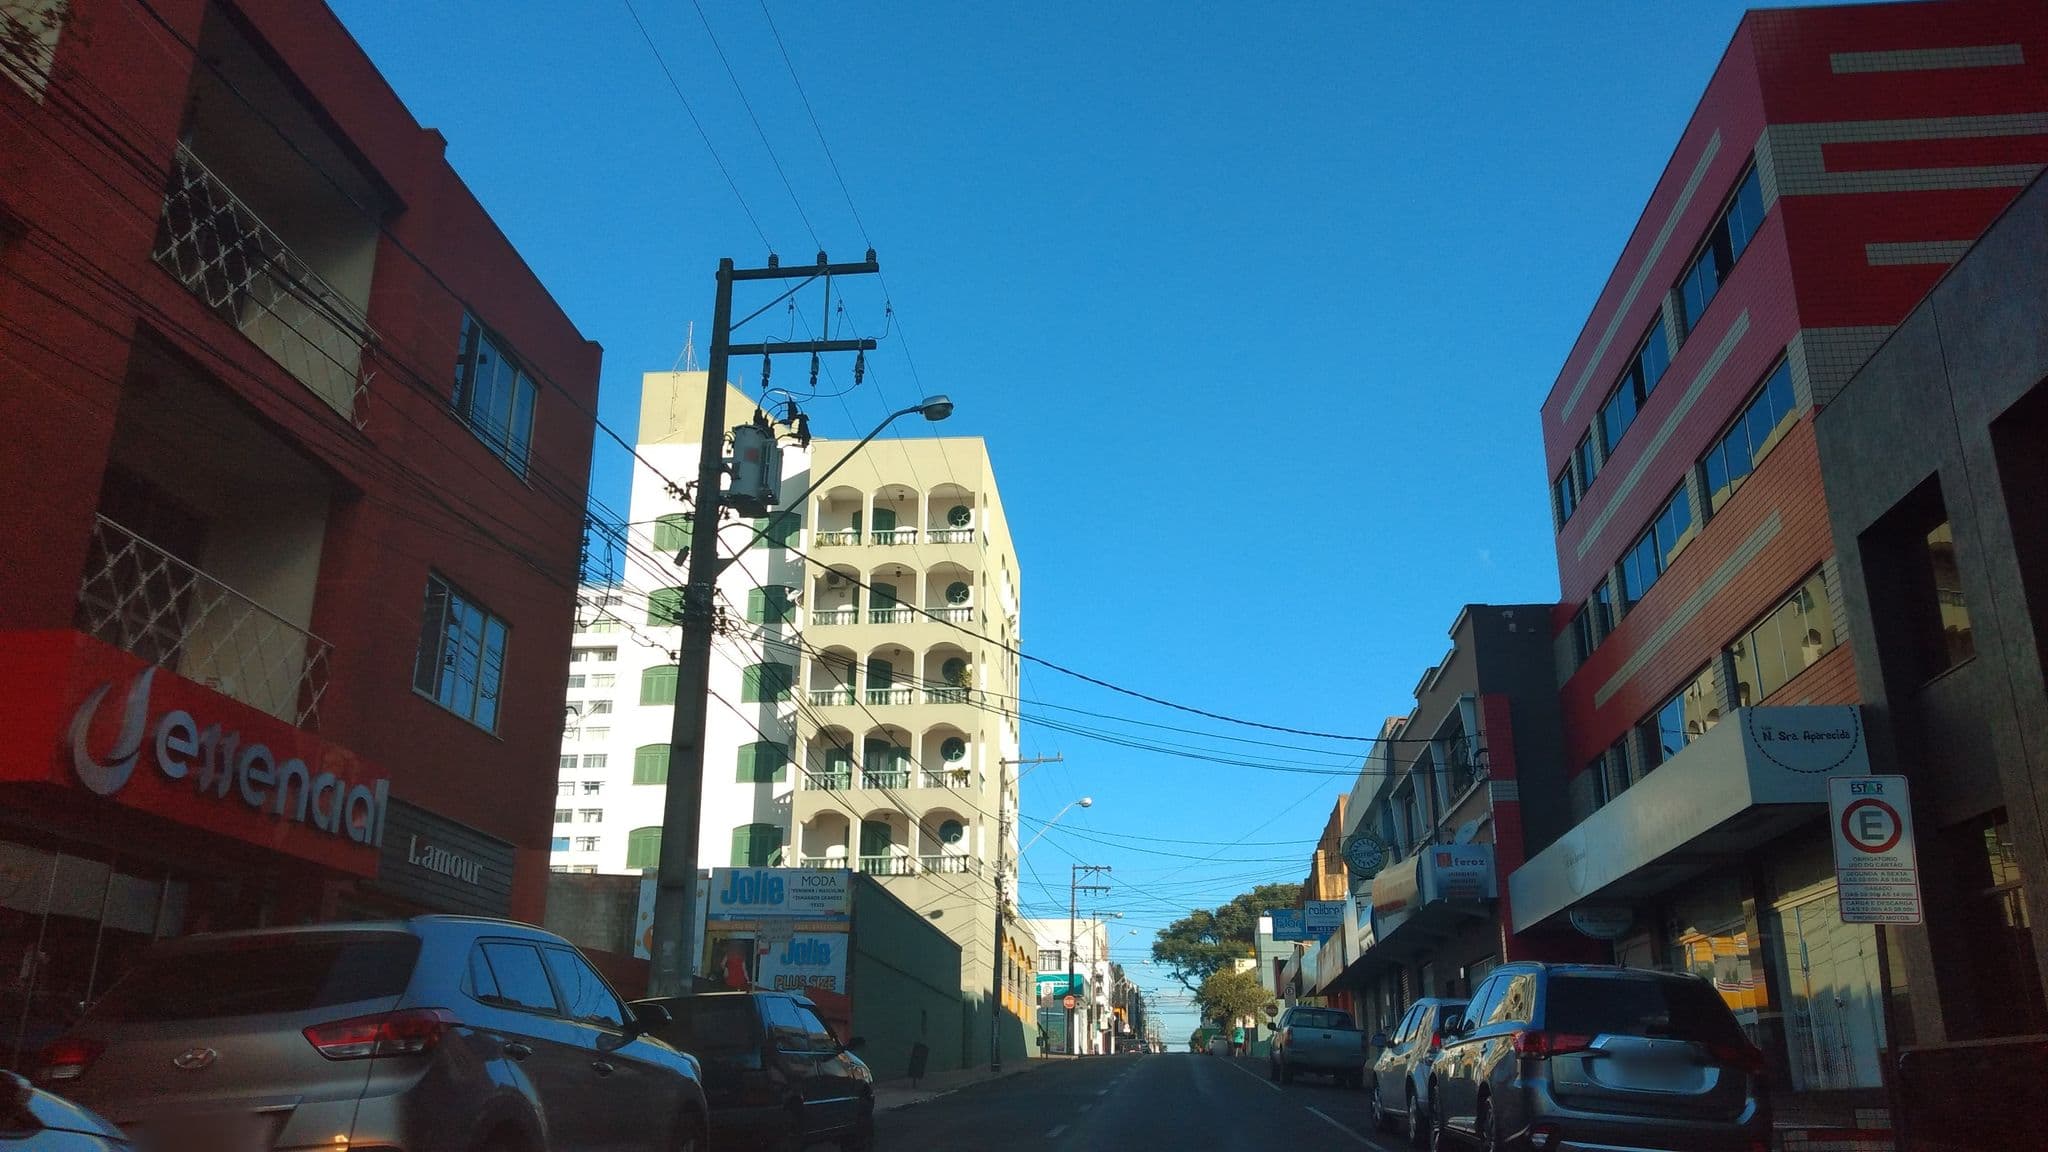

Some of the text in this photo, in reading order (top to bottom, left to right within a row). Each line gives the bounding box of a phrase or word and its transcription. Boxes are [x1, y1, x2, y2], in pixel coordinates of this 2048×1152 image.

[1803, 729, 1850, 743] Aparecida
[156, 709, 390, 848] essencial
[1851, 782, 1883, 793] ESTAR
[1859, 811, 1884, 840] E
[720, 870, 785, 905] Jolie
[801, 876, 836, 887] MODA
[781, 938, 831, 966] Jolie
[775, 975, 836, 991] PLUS SIZE
